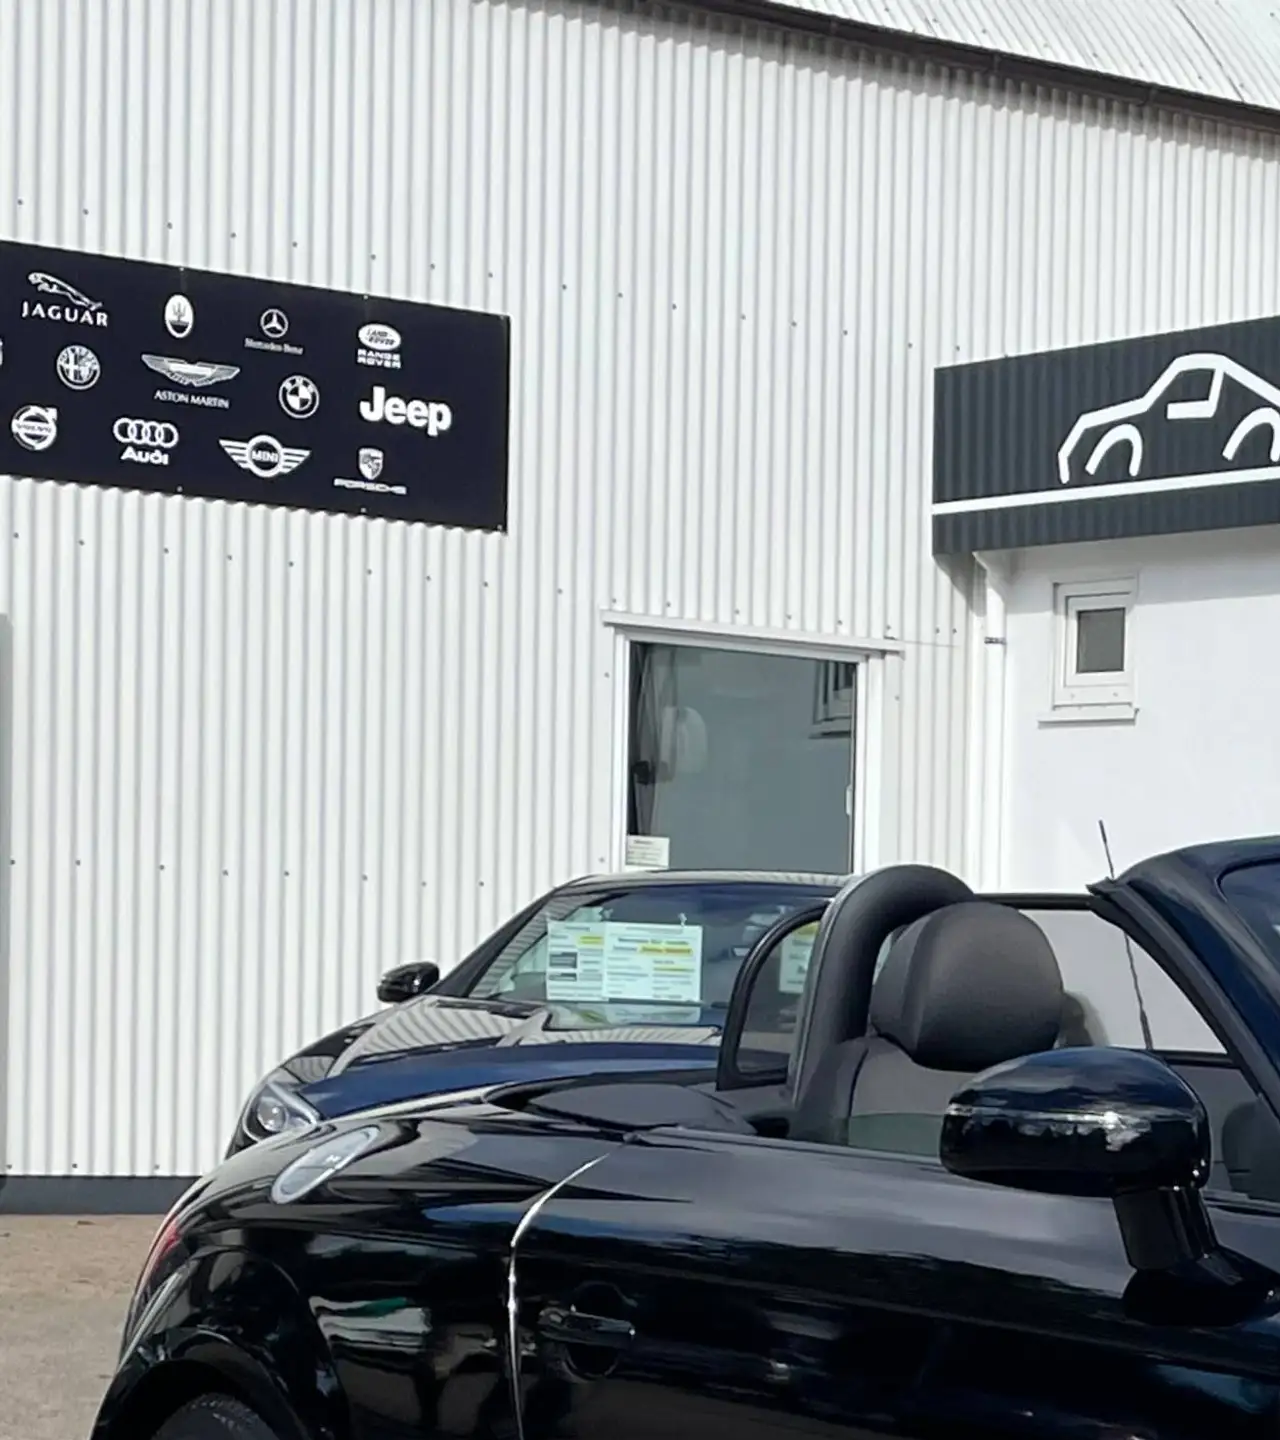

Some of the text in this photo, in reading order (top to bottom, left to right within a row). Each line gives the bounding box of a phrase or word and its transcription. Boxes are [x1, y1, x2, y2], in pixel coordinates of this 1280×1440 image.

[21, 300, 109, 327] JAGUAR
[154, 389, 230, 409] ASTON MARTIN
[359, 385, 452, 437] Jeep
[120, 445, 170, 465] Audi
[250, 448, 280, 463] MINI
